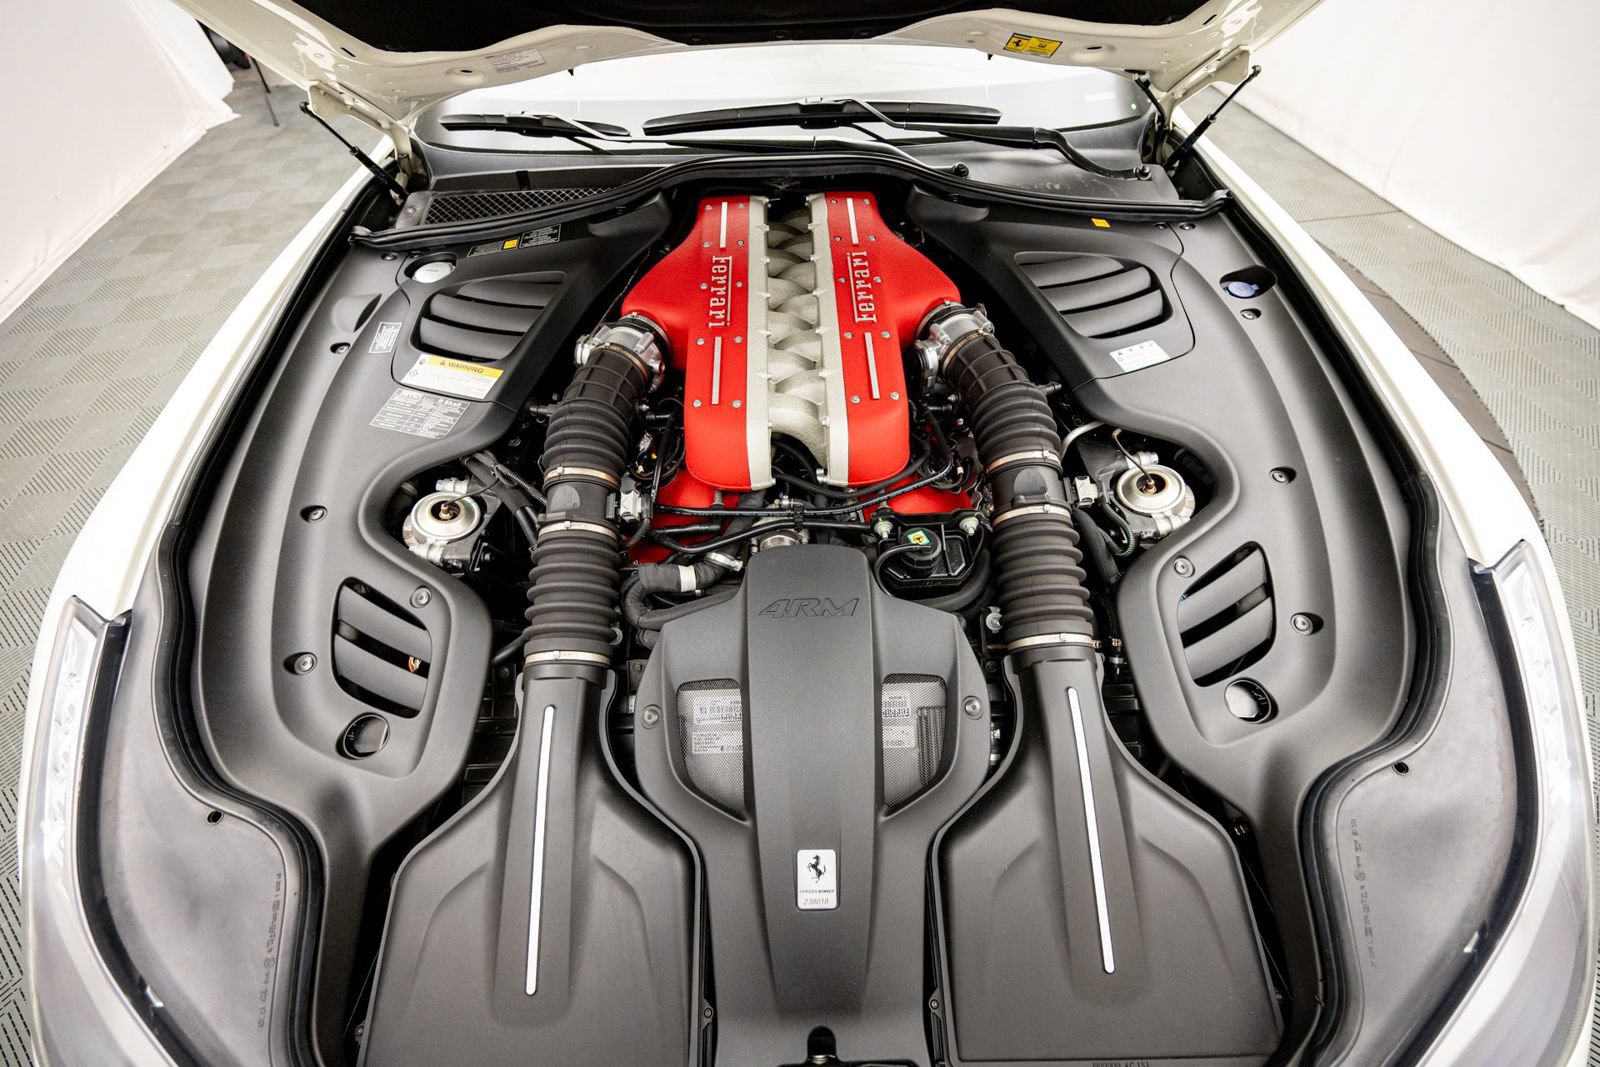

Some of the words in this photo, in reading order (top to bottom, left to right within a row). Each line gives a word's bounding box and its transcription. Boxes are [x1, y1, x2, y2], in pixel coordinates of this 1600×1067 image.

[708, 255, 733, 329] Ferrari
[846, 250, 878, 324] Ferrari
[448, 360, 484, 374] WARNING
[759, 597, 859, 619] 4RM
